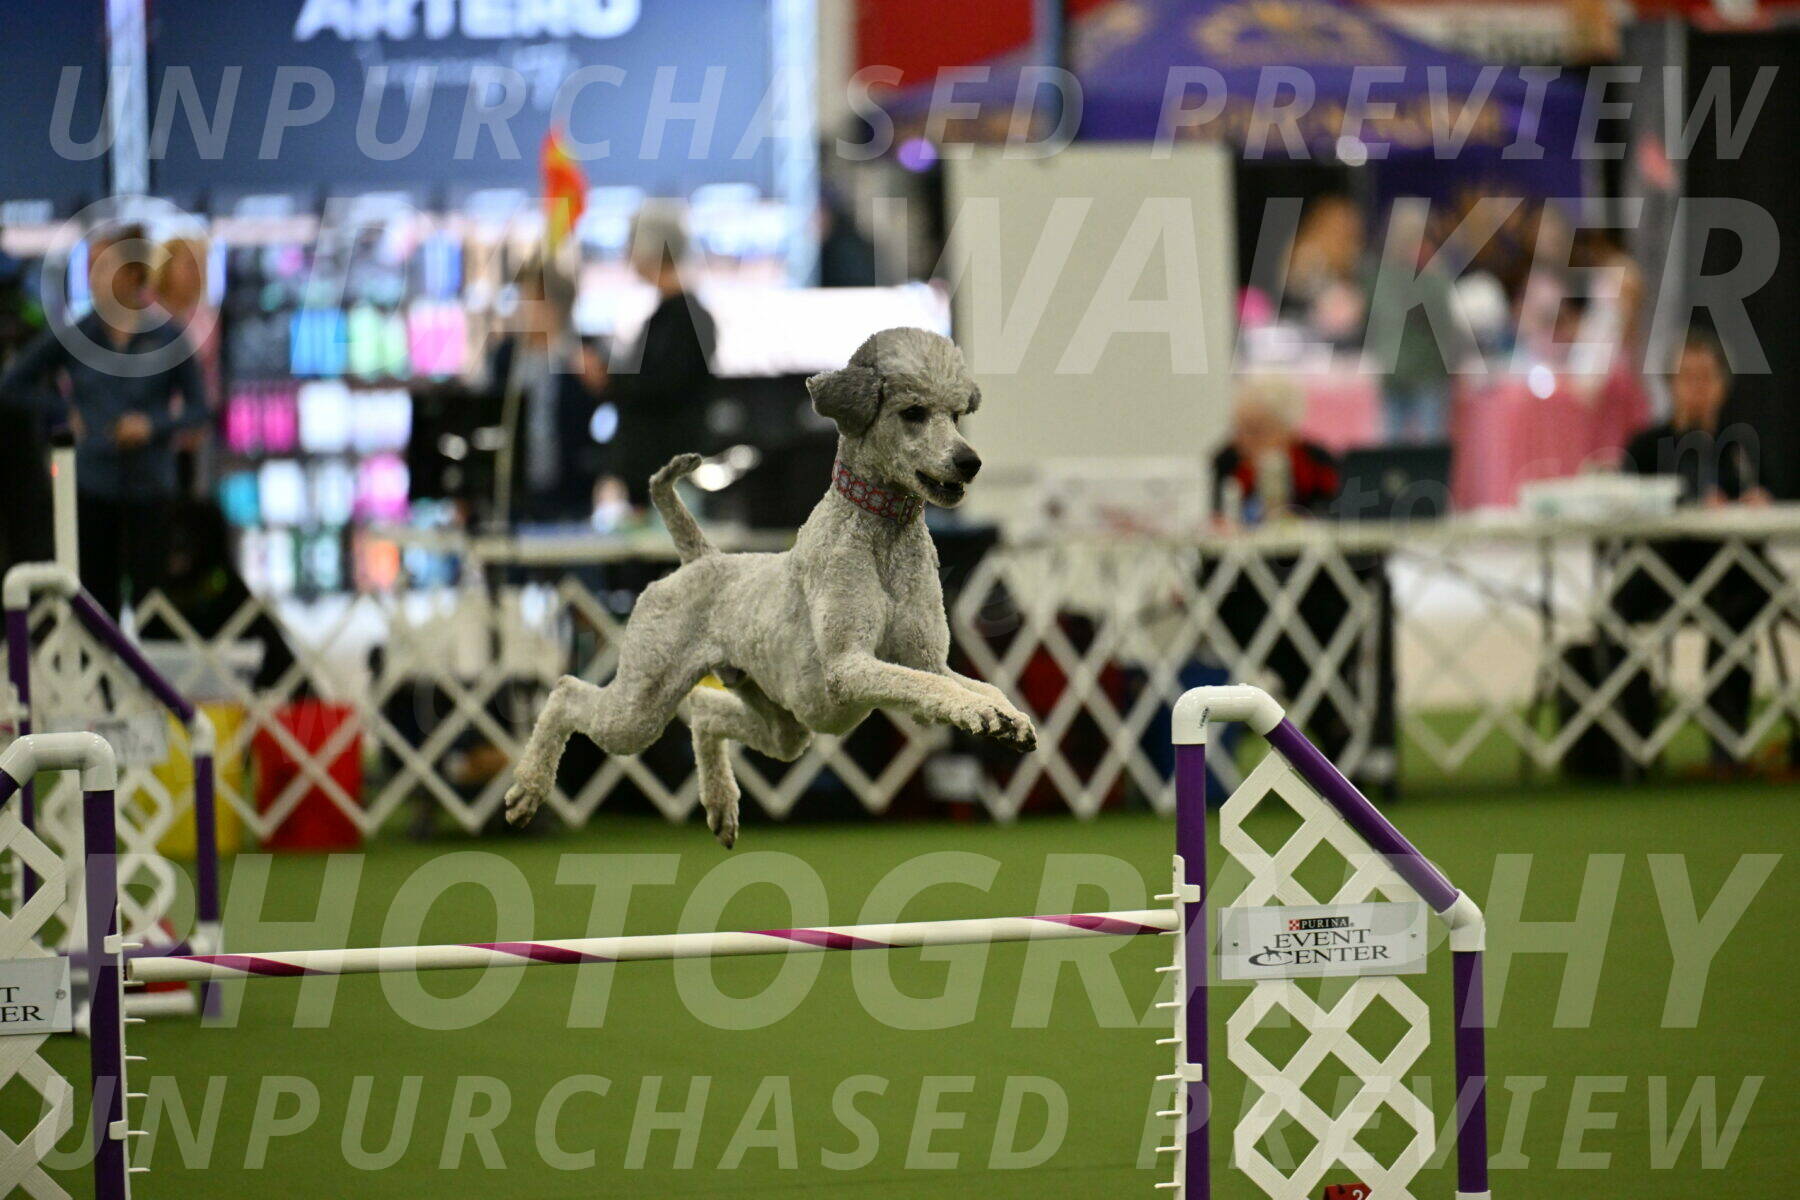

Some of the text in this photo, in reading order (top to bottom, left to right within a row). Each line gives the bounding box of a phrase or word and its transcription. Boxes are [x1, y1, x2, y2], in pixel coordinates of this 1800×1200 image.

[1301, 917, 1348, 929] PURINA
[1274, 929, 1371, 949] EVENT
[1248, 945, 1391, 966] CENTER
